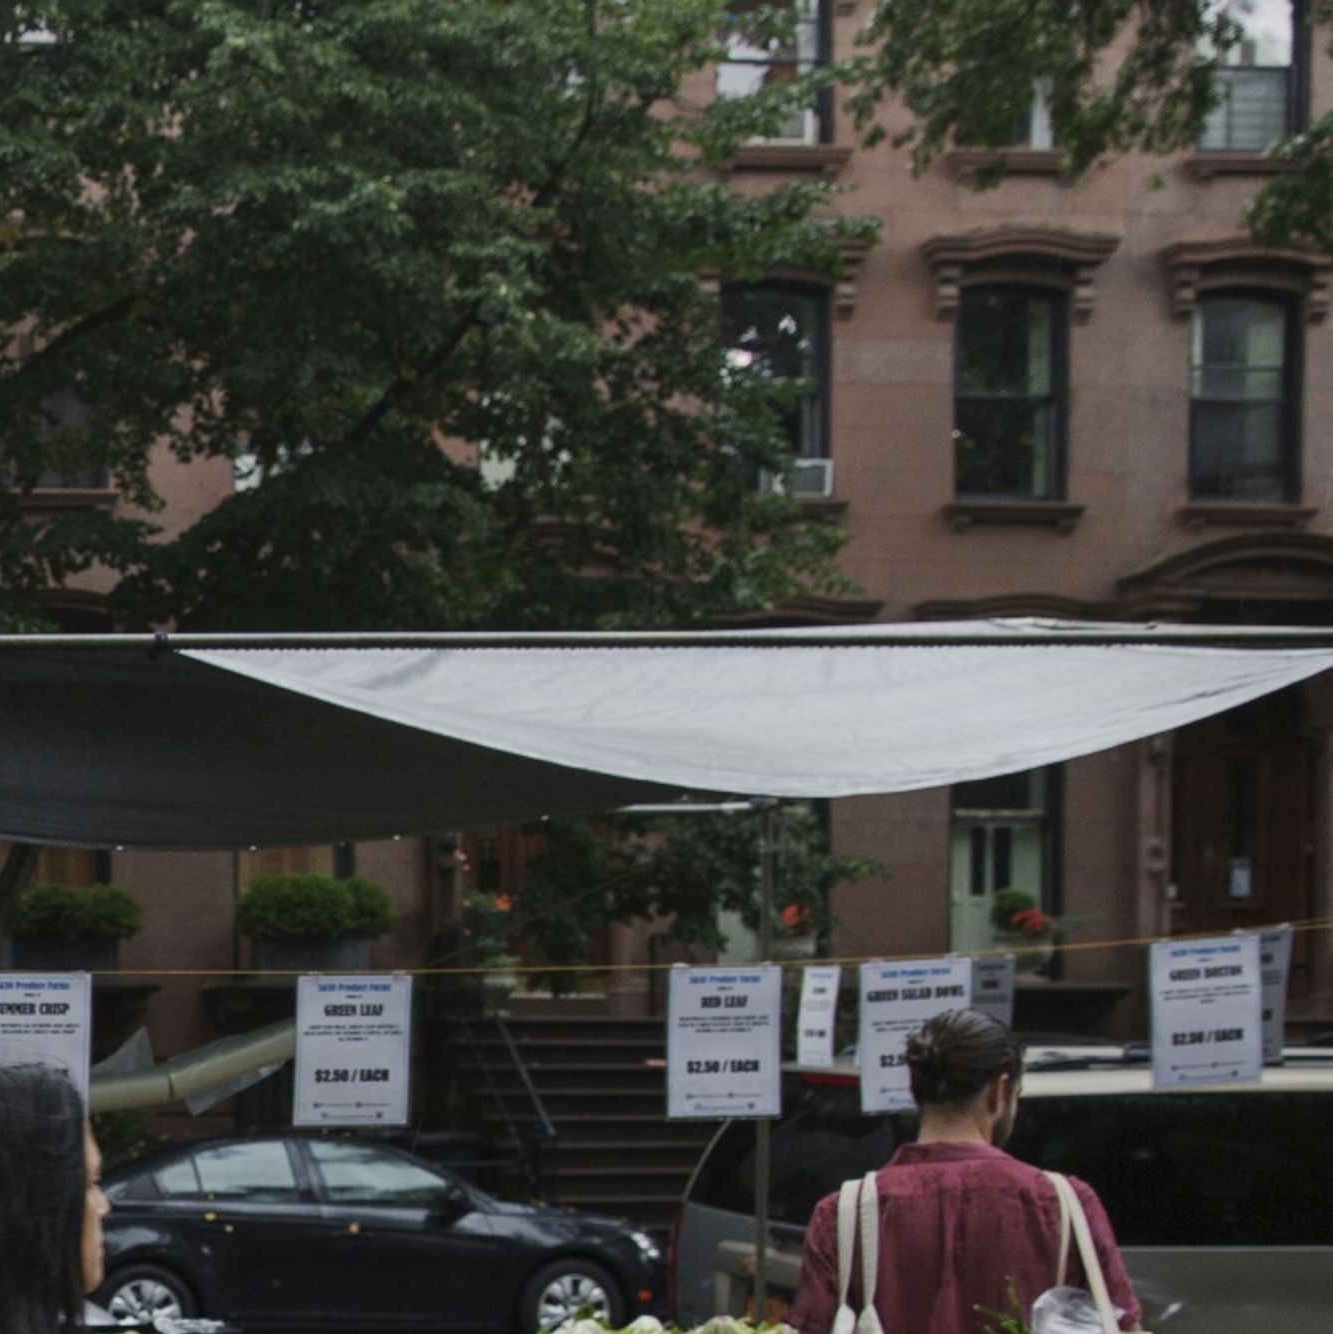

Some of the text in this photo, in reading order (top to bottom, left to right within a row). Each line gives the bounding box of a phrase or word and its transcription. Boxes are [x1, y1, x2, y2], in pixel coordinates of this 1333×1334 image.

[15, 980, 45, 990] Produce
[47, 981, 70, 990] Farms
[337, 983, 368, 992] Produce
[867, 985, 965, 1003] GREEN SALAD BOWL
[39, 1003, 71, 1015] CRISP
[700, 995, 749, 1009] RED LEAF
[324, 1003, 384, 1017] GREEN LEAF
[687, 1060, 720, 1074] $2.50
[730, 1059, 760, 1073] EACH
[880, 1054, 904, 1068] $2.5
[314, 1069, 348, 1083] $2.50
[359, 1069, 390, 1082] EACH
